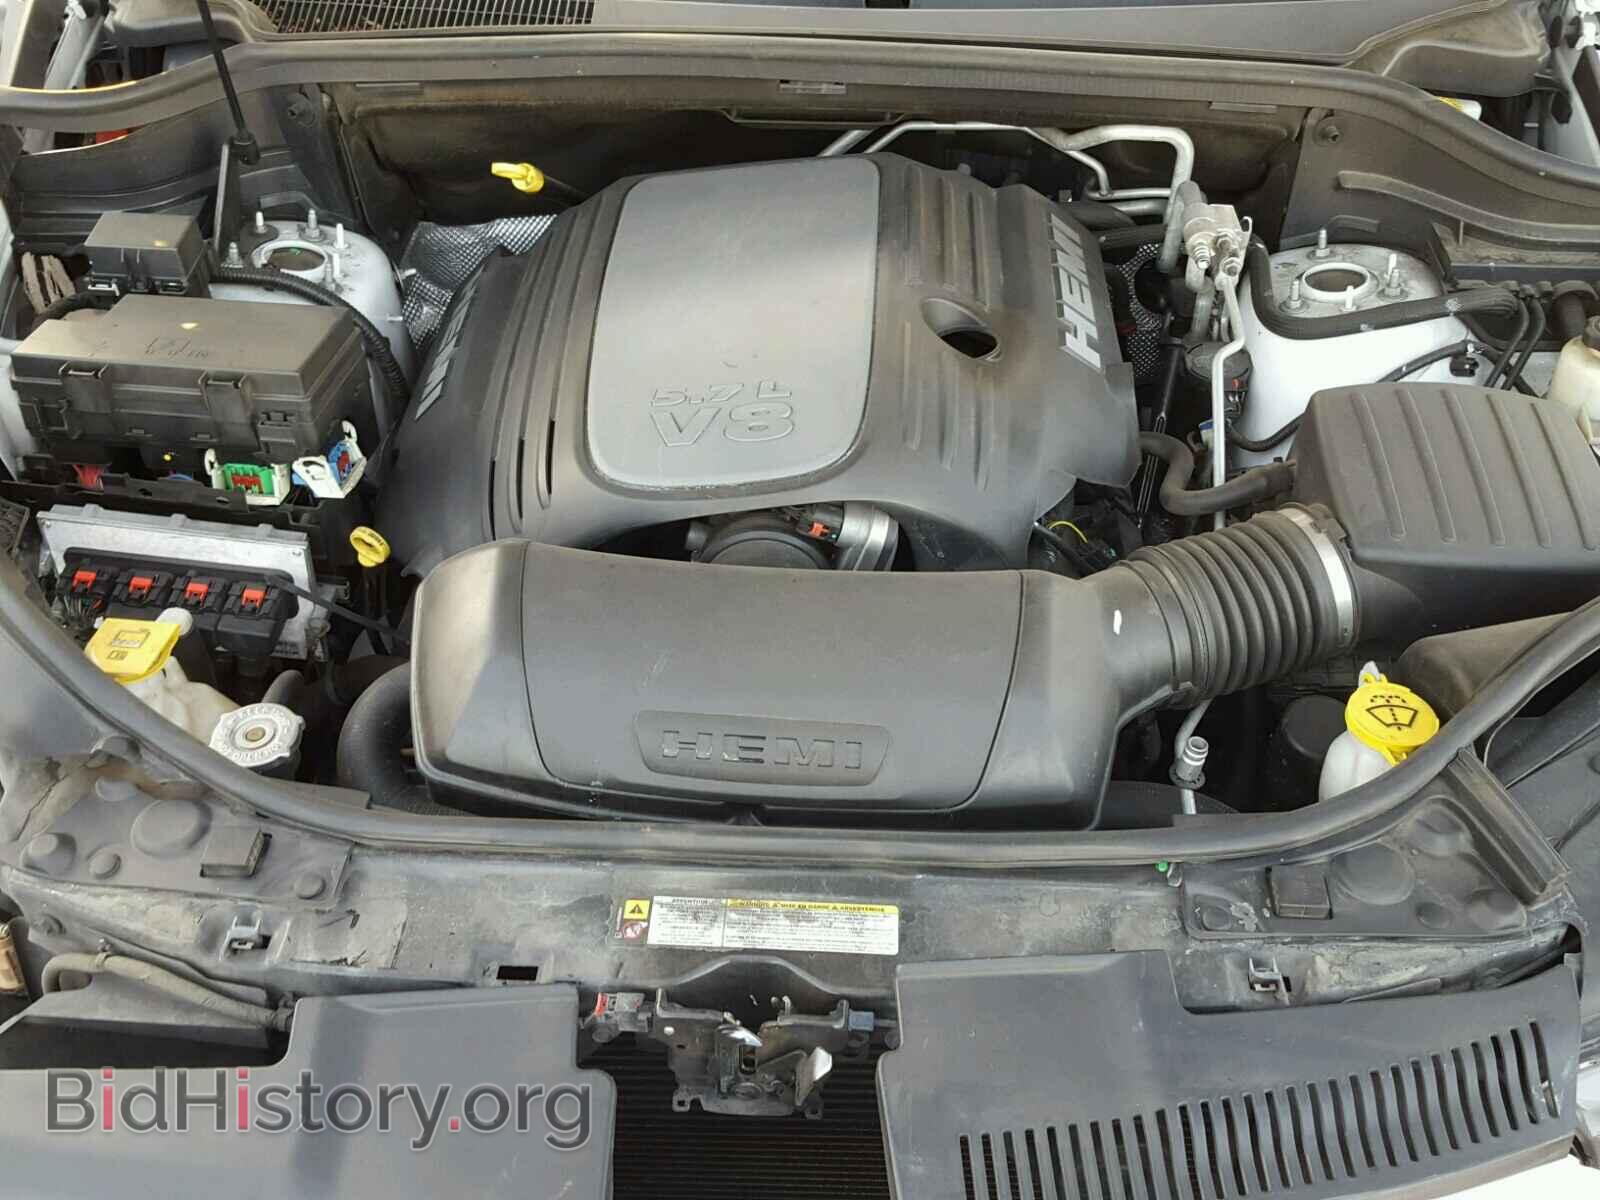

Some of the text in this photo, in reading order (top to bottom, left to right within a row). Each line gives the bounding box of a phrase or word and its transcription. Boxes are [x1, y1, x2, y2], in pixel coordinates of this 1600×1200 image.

[1051, 213, 1101, 369] HEMI
[650, 401, 796, 447] V8
[661, 730, 863, 769] HEMI
